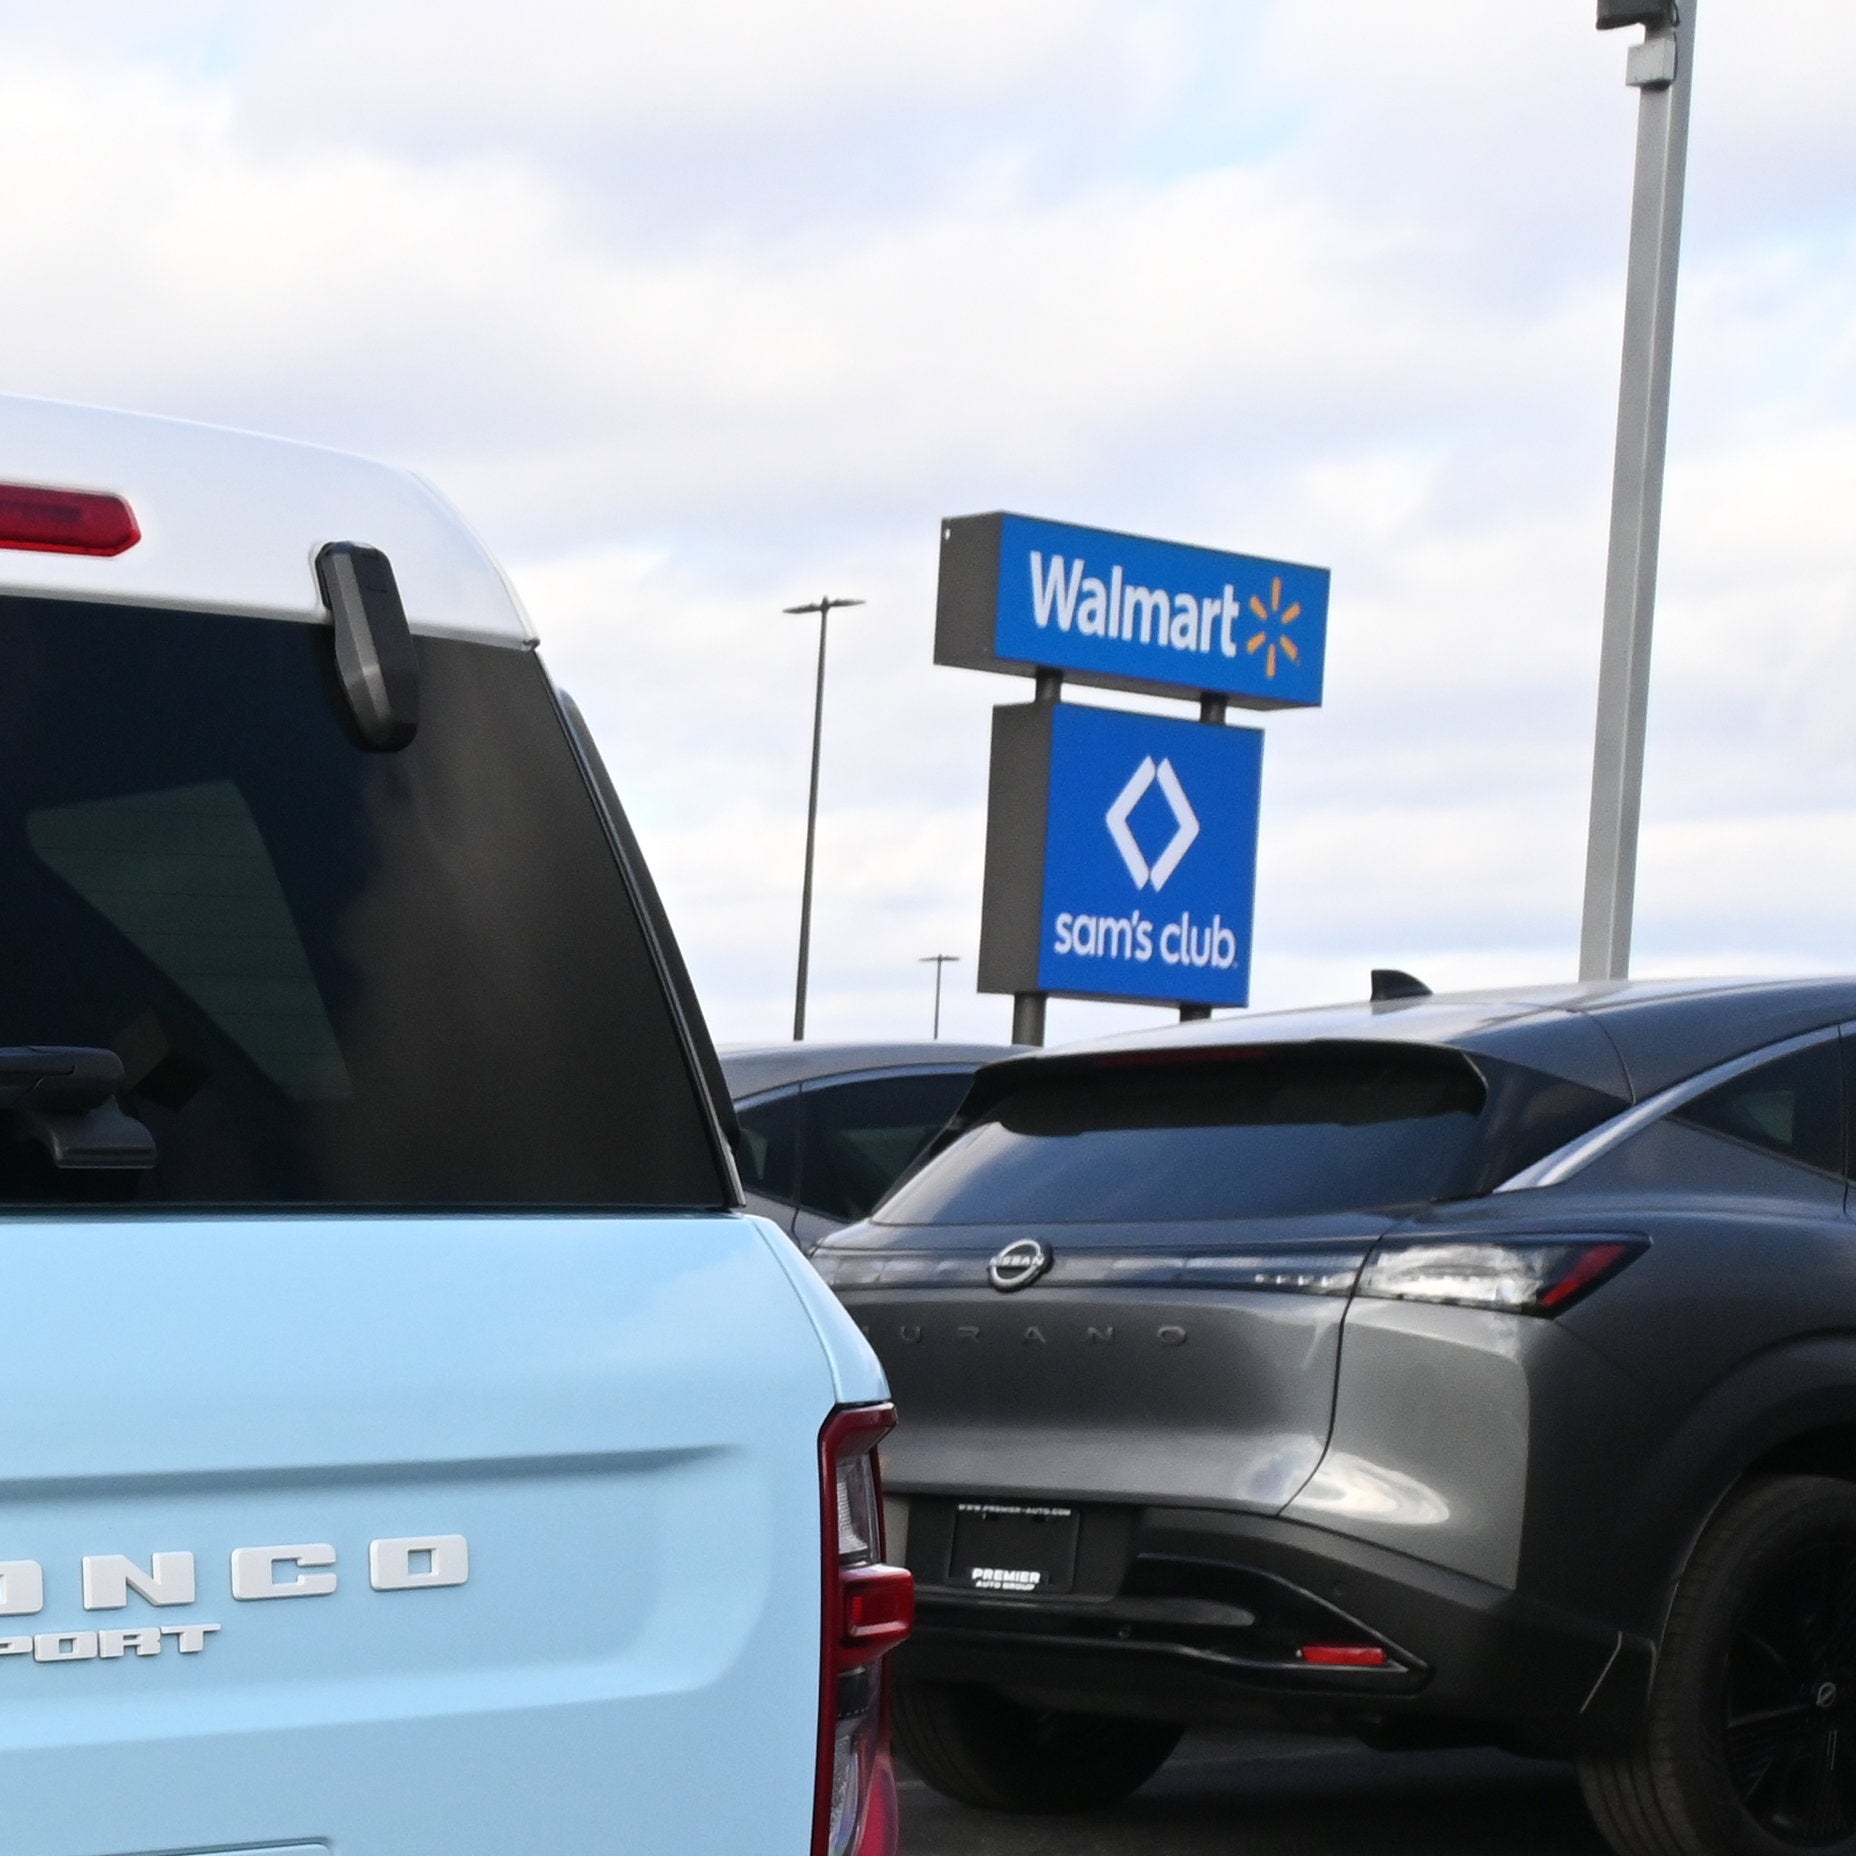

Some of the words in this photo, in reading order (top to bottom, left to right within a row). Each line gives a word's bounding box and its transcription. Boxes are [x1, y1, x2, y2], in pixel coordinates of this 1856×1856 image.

[1030, 550, 1239, 658] Walmart
[1055, 910, 1152, 961] sam's
[1160, 912, 1236, 968] club
[990, 1254, 1045, 1268] NISSAN
[971, 1567, 1041, 1584] PREMIER
[975, 1580, 1001, 1588] AUTO
